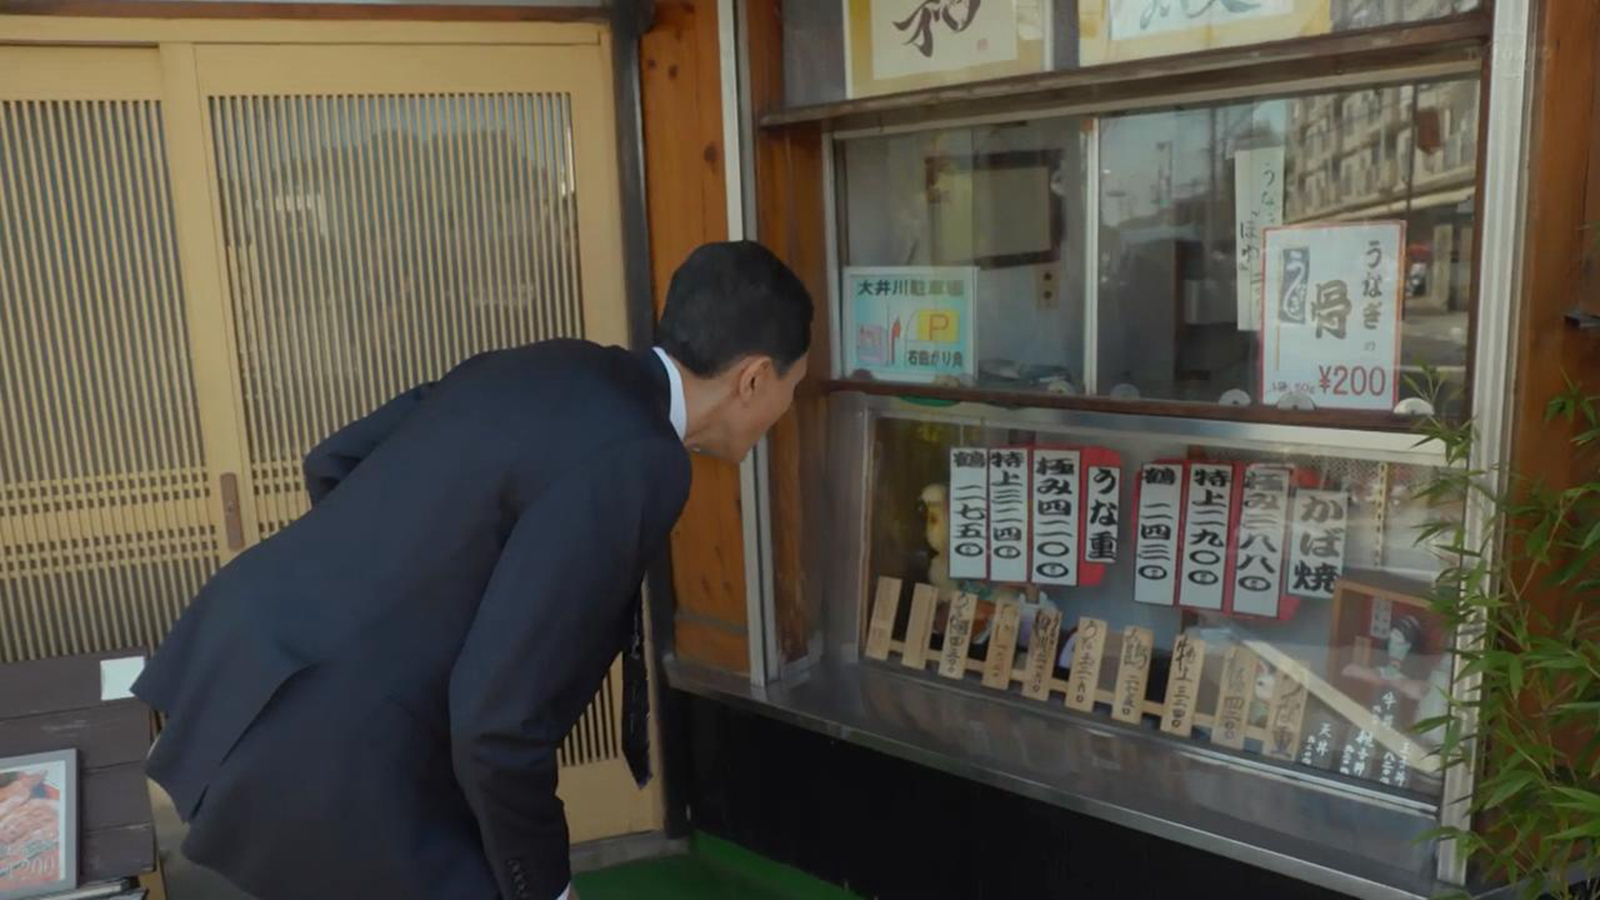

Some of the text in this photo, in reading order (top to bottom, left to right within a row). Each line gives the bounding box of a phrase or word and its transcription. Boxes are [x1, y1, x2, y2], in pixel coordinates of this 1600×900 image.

[1319, 366, 1386, 396] ¥200
[1088, 468, 1117, 560] うな重
[1293, 495, 1344, 594] かば焼
